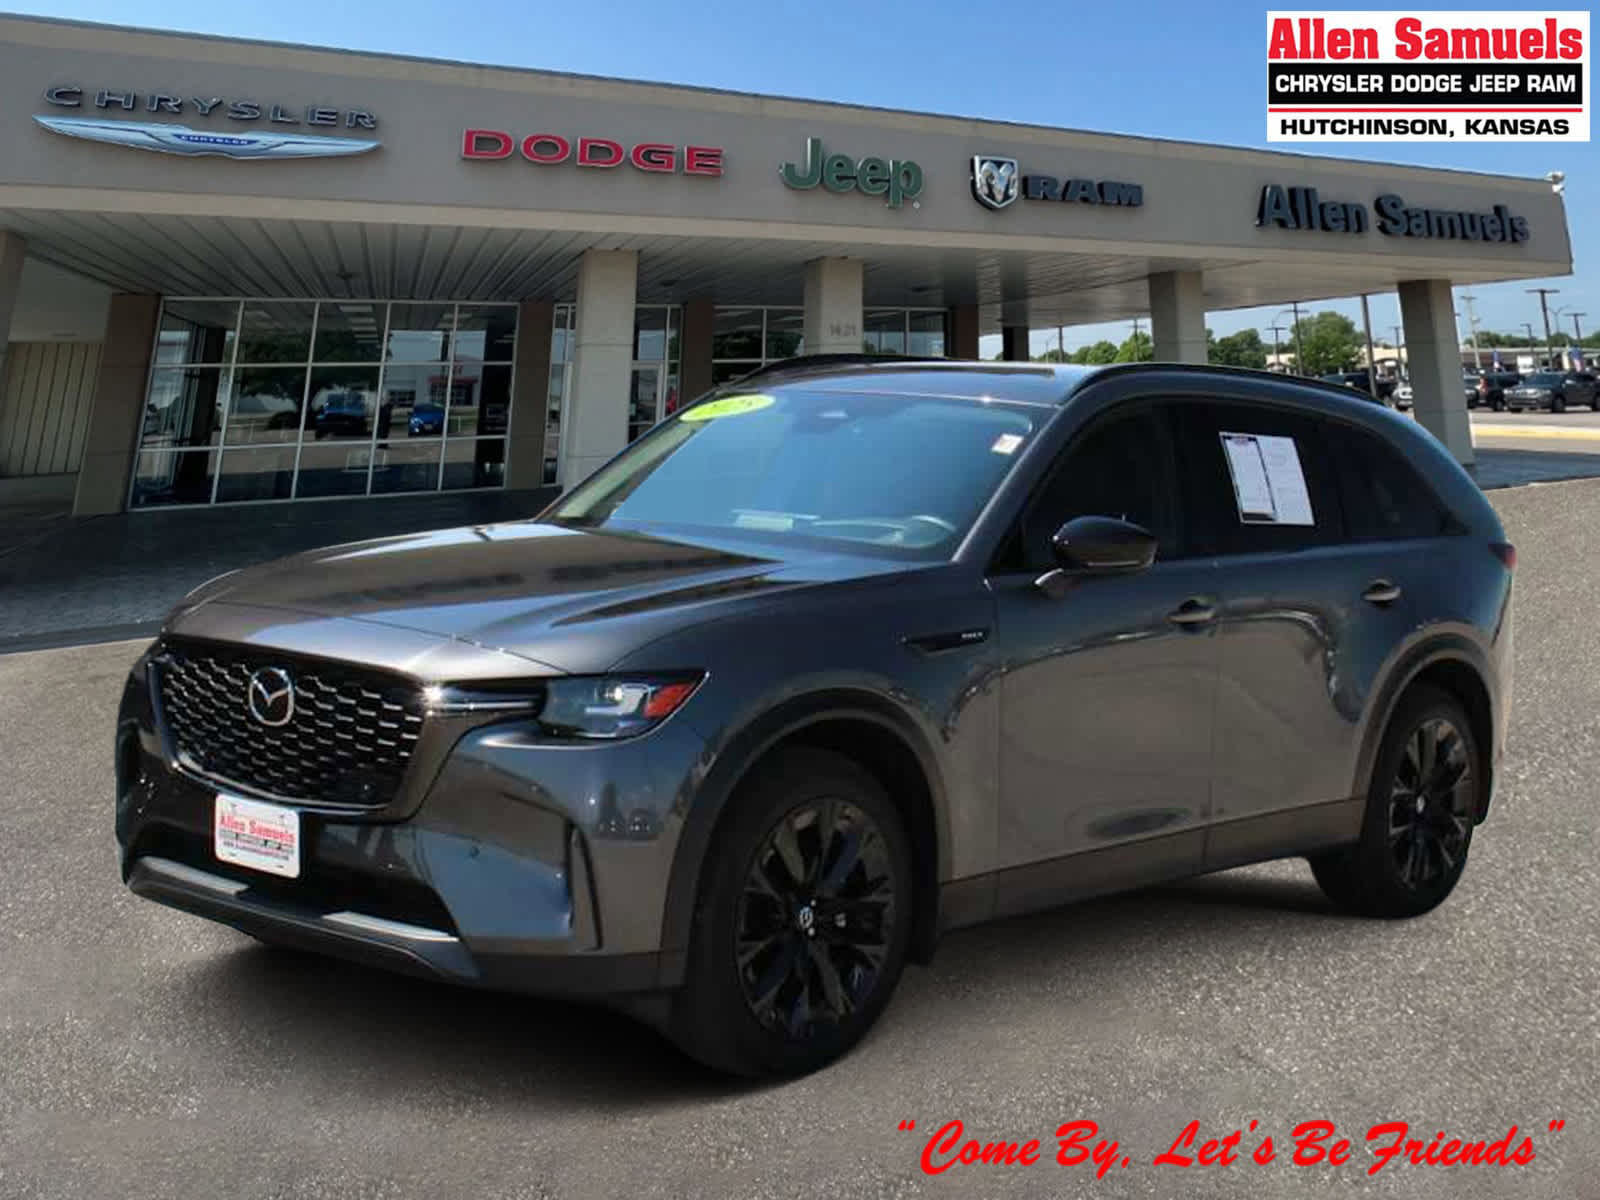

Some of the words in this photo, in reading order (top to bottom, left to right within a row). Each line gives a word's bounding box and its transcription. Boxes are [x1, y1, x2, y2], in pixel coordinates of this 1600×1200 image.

[43, 86, 378, 129] CHRYSLER
[462, 127, 725, 177] DODGE
[779, 136, 924, 209] Jeep
[1022, 175, 1144, 207] RAM
[1256, 184, 1369, 233] Allen
[1374, 194, 1530, 243] Samuels
